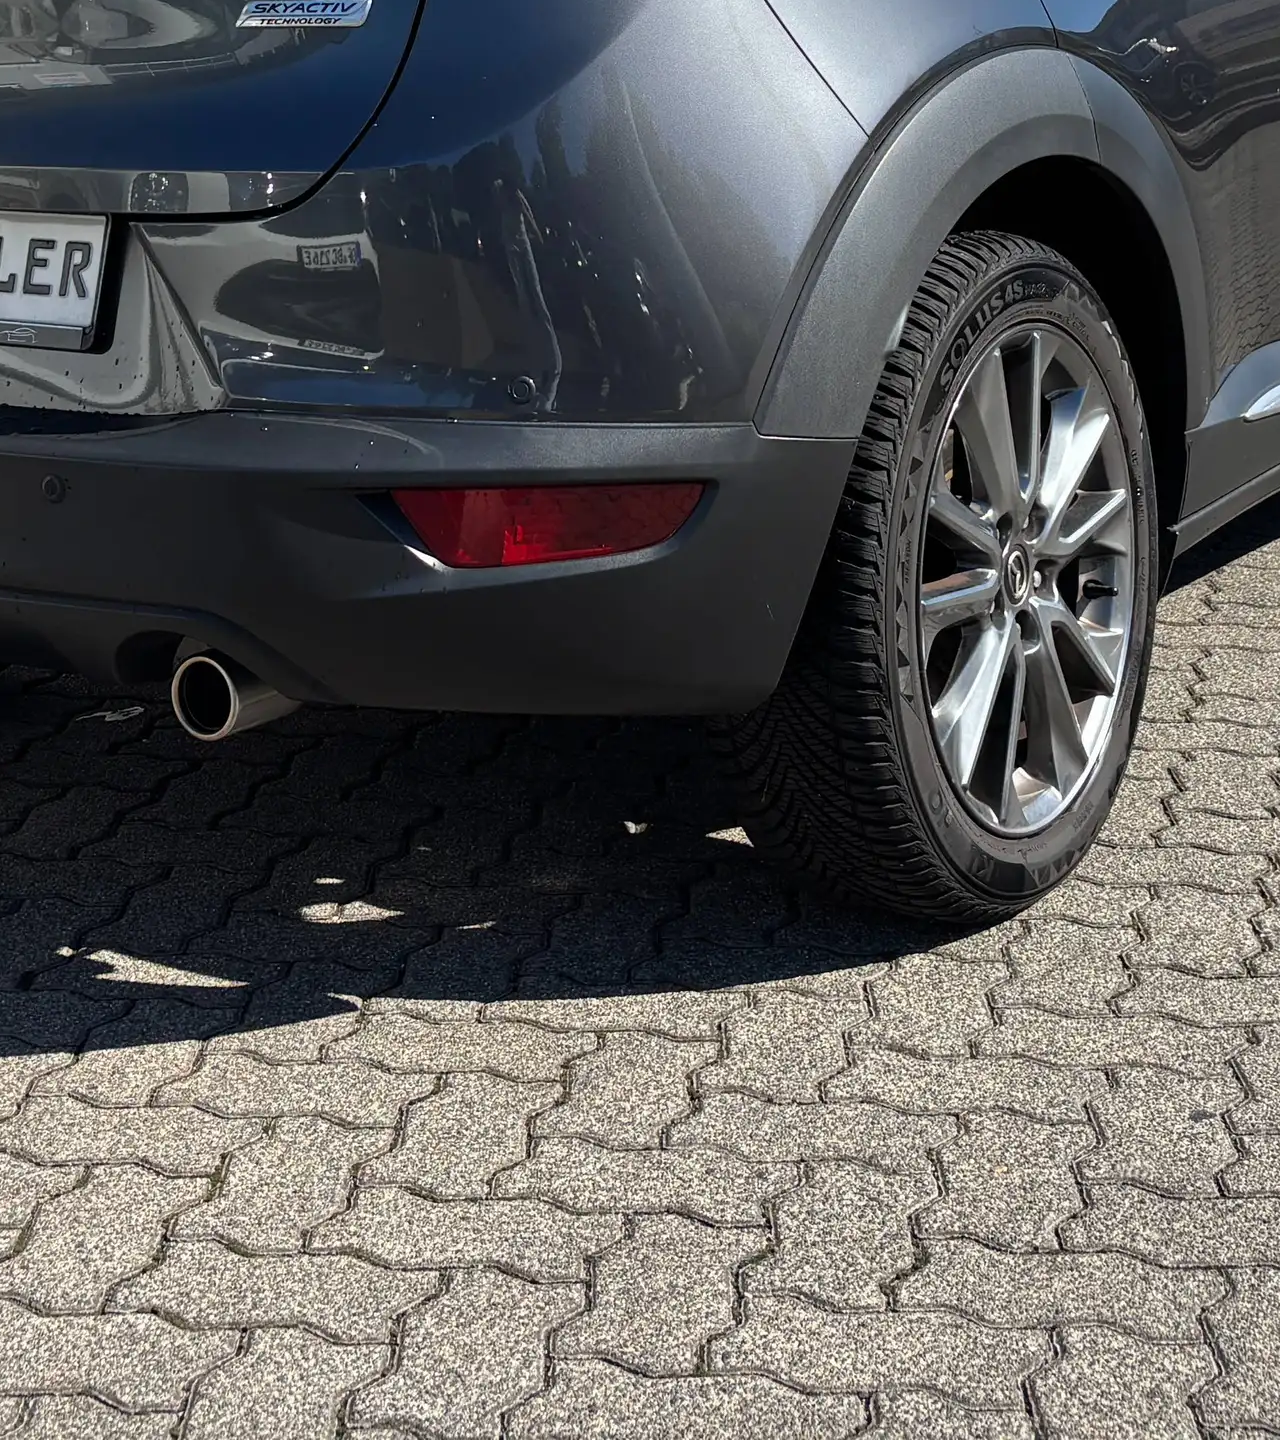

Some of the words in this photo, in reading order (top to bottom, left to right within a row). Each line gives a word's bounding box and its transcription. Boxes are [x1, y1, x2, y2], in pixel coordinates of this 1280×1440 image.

[252, 2, 357, 14] SKYACTIV
[260, 17, 342, 25] TECHNOLOGY
[940, 291, 1004, 389] SOLUS
